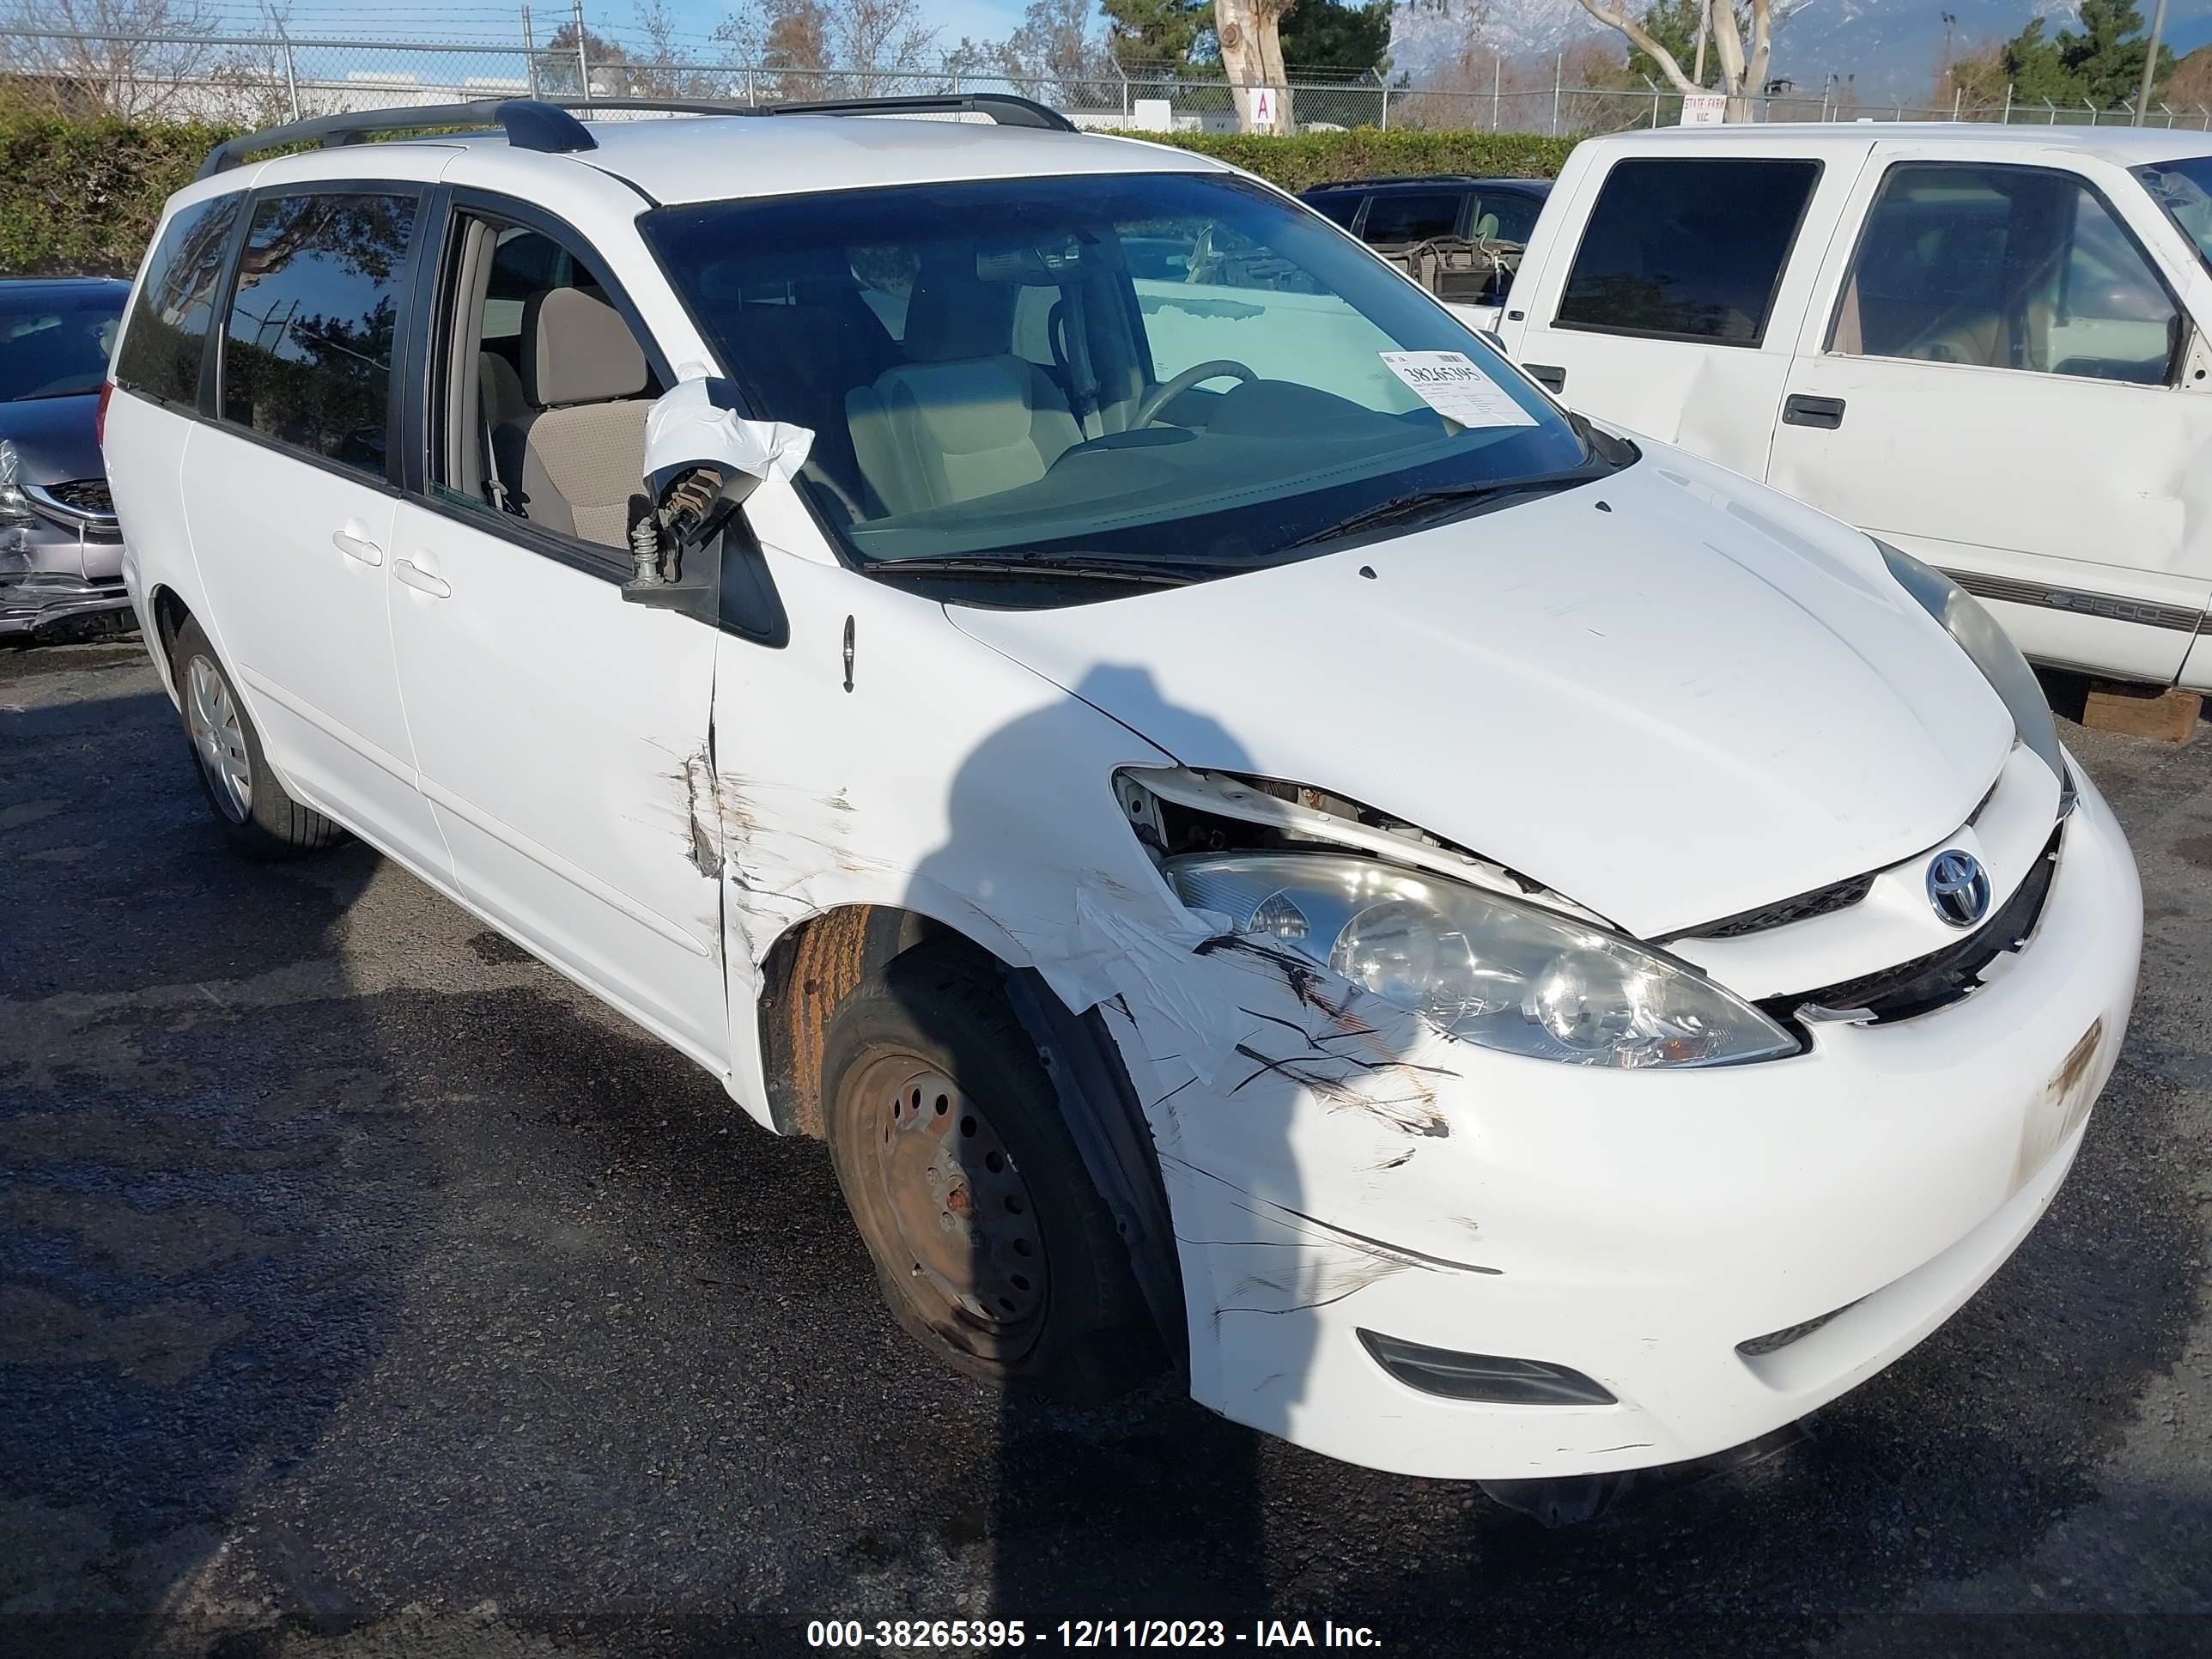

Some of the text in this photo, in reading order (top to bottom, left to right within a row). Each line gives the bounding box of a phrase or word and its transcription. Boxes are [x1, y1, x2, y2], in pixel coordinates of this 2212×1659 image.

[1257, 90, 1269, 119] A
[1684, 98, 1705, 109] STATE
[1403, 368, 1481, 382] 38265395
